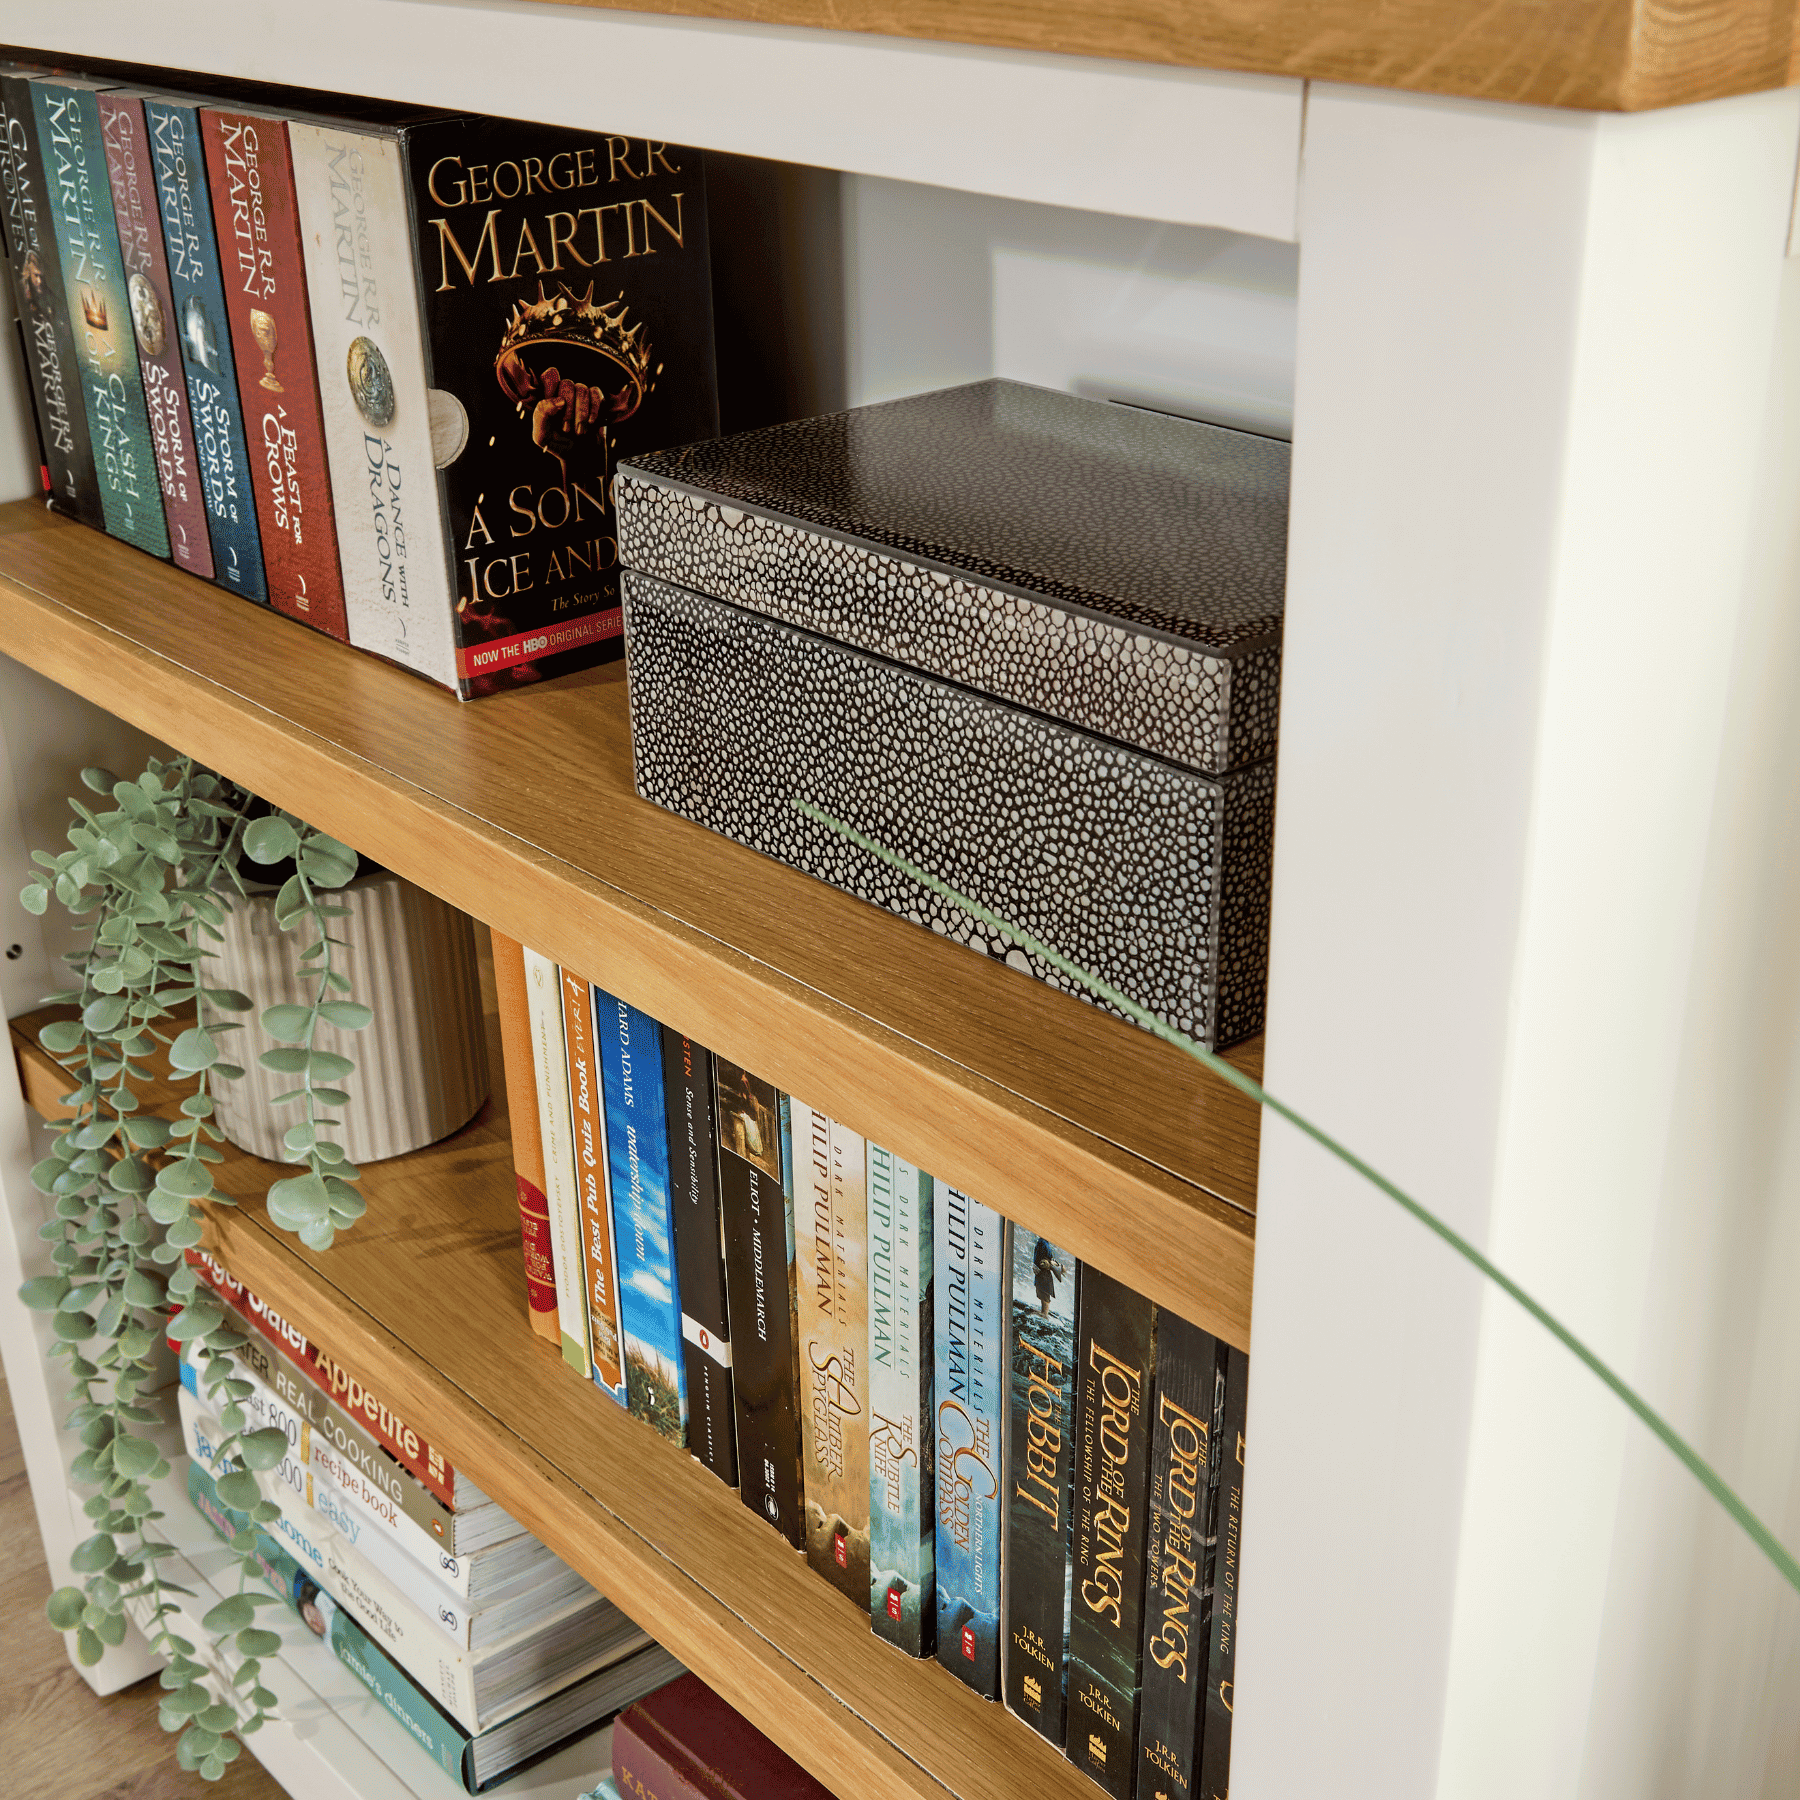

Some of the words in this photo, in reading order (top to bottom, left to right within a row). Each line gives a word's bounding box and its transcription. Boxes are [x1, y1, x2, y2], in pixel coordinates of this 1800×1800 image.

[9, 117, 38, 222] GAME
[67, 97, 95, 223] GEORGE
[100, 105, 138, 271] MARTIN
[118, 111, 144, 219] GEORGE
[170, 115, 194, 227] GEORGE
[244, 126, 268, 242] GEORGE
[427, 148, 600, 208] GEORGE
[45, 94, 91, 287] MARTIN
[150, 110, 190, 282] MARTIN
[220, 118, 260, 298] MARTIN
[349, 148, 372, 270] GEORGE
[324, 138, 363, 328] MARTIN
[428, 192, 684, 292] MARTIN
[44, 322, 68, 415] GEORGE
[86, 331, 103, 376] OF
[160, 366, 170, 379] A
[32, 318, 70, 453] MARTIN
[211, 384, 220, 398] A
[277, 404, 288, 418] A
[93, 385, 122, 492] KINGS
[102, 337, 116, 357] A
[109, 373, 140, 498] CLASH
[146, 361, 176, 498] SWORDS
[163, 386, 188, 477] STORM
[383, 439, 392, 453] A
[196, 378, 227, 518] SWORDS
[215, 405, 238, 498] STORM
[262, 413, 290, 530] CROWS
[280, 425, 302, 514] FEAST
[178, 482, 188, 502] OF
[230, 504, 238, 523] OF
[364, 430, 396, 603] DRAGONS
[386, 459, 408, 560] DANCE
[292, 515, 302, 544] FOR
[398, 565, 410, 608] WITH
[464, 552, 534, 605] ICE
[545, 536, 618, 586] AND
[551, 598, 570, 612] The
[572, 591, 600, 608] Story
[604, 585, 615, 598] So
[473, 650, 500, 666] NOW
[500, 644, 520, 658] THE
[522, 636, 548, 654] HBO
[550, 624, 594, 646] ORIGINAL
[596, 616, 623, 634] SERIE
[540, 1025, 552, 1097] PUNISHMENT
[621, 1050, 634, 1108] ADAMS
[683, 1035, 692, 1078] STEN
[546, 1102, 555, 1125] AND
[574, 1057, 590, 1115] Book
[685, 1086, 694, 1120] Sense
[548, 1129, 559, 1164] CRIME
[582, 1118, 598, 1168] Quiz
[688, 1122, 697, 1146] and
[812, 1108, 827, 1178] HILIP
[585, 1172, 599, 1216] Pub
[690, 1147, 700, 1205] Sensibility
[750, 1169, 760, 1215] ELIOT
[834, 1145, 843, 1197] DARK
[872, 1146, 890, 1228] HILIP
[590, 1218, 604, 1264] Best
[899, 1195, 909, 1246] DARK
[948, 1188, 966, 1260] HILIP
[814, 1182, 832, 1318] PULLMAN
[836, 1214, 848, 1326] MATERIALS
[974, 1227, 984, 1280] DARK
[594, 1268, 606, 1306] The
[752, 1228, 768, 1342] MIDDLEMARCH
[873, 1234, 892, 1369] PULLMAN
[899, 1265, 910, 1379] MATERIALS
[948, 1264, 966, 1404] PULLMAN
[842, 1347, 854, 1386] THE
[972, 1298, 984, 1413] MATERIALS
[314, 1348, 420, 1462] Appetite
[808, 1339, 836, 1483] SPYGLASS
[826, 1353, 862, 1480] AMBER
[1086, 1378, 1096, 1404] THE
[1090, 1338, 1141, 1466] LORD
[1130, 1383, 1141, 1416] THE
[276, 1370, 316, 1424] REAL
[323, 1416, 403, 1504] COOKING
[706, 1416, 714, 1462] CLASSICS
[869, 1405, 903, 1478] KNIFE
[902, 1413, 912, 1454] THE
[975, 1417, 990, 1458] THE
[1018, 1334, 1064, 1532] HOBBIT
[1084, 1408, 1095, 1482] FELLOWSHIP
[1160, 1390, 1209, 1519] LORD
[1198, 1440, 1208, 1468] THE
[314, 1446, 360, 1494] recipe
[362, 1480, 398, 1528] book
[888, 1445, 918, 1514] SUBTLE
[938, 1400, 977, 1530] COMPASS
[1083, 1486, 1091, 1502] OF
[1101, 1456, 1114, 1496] THE
[1112, 1469, 1126, 1499] OF
[1154, 1474, 1163, 1500] THE
[318, 1492, 362, 1544] easy
[954, 1446, 999, 1555] GOLDEN
[974, 1492, 984, 1555] NORTHERN
[1082, 1507, 1090, 1532] THE
[1152, 1503, 1162, 1533] TWO
[1230, 1486, 1240, 1511] THE
[1080, 1536, 1090, 1566] RING
[1082, 1484, 1130, 1628] RINGS
[1168, 1512, 1181, 1550] THE
[1180, 1523, 1192, 1552] OF
[1226, 1514, 1238, 1570] RETURN
[974, 1554, 984, 1596] LIGHTS
[1150, 1537, 1160, 1588] TOWERS
[1224, 1572, 1234, 1591] OF
[350, 1577, 372, 1604] Your
[372, 1599, 393, 1628] Way
[394, 1624, 404, 1637] to
[356, 1598, 378, 1624] Good
[378, 1618, 396, 1642] Life
[1150, 1539, 1196, 1684] RINGS
[1222, 1592, 1234, 1618] THE
[1013, 1632, 1054, 1672] TOLKIEN
[1023, 1626, 1046, 1651] J.R.R.
[1220, 1623, 1232, 1656] KING
[338, 1640, 382, 1696] jamie's
[384, 1692, 434, 1750] dinners
[1078, 1690, 1120, 1732] TOLKIEN
[1089, 1684, 1112, 1710] J.R.R.
[1144, 1746, 1188, 1790] TOLKIEN
[1156, 1740, 1180, 1768] J.R.R.
